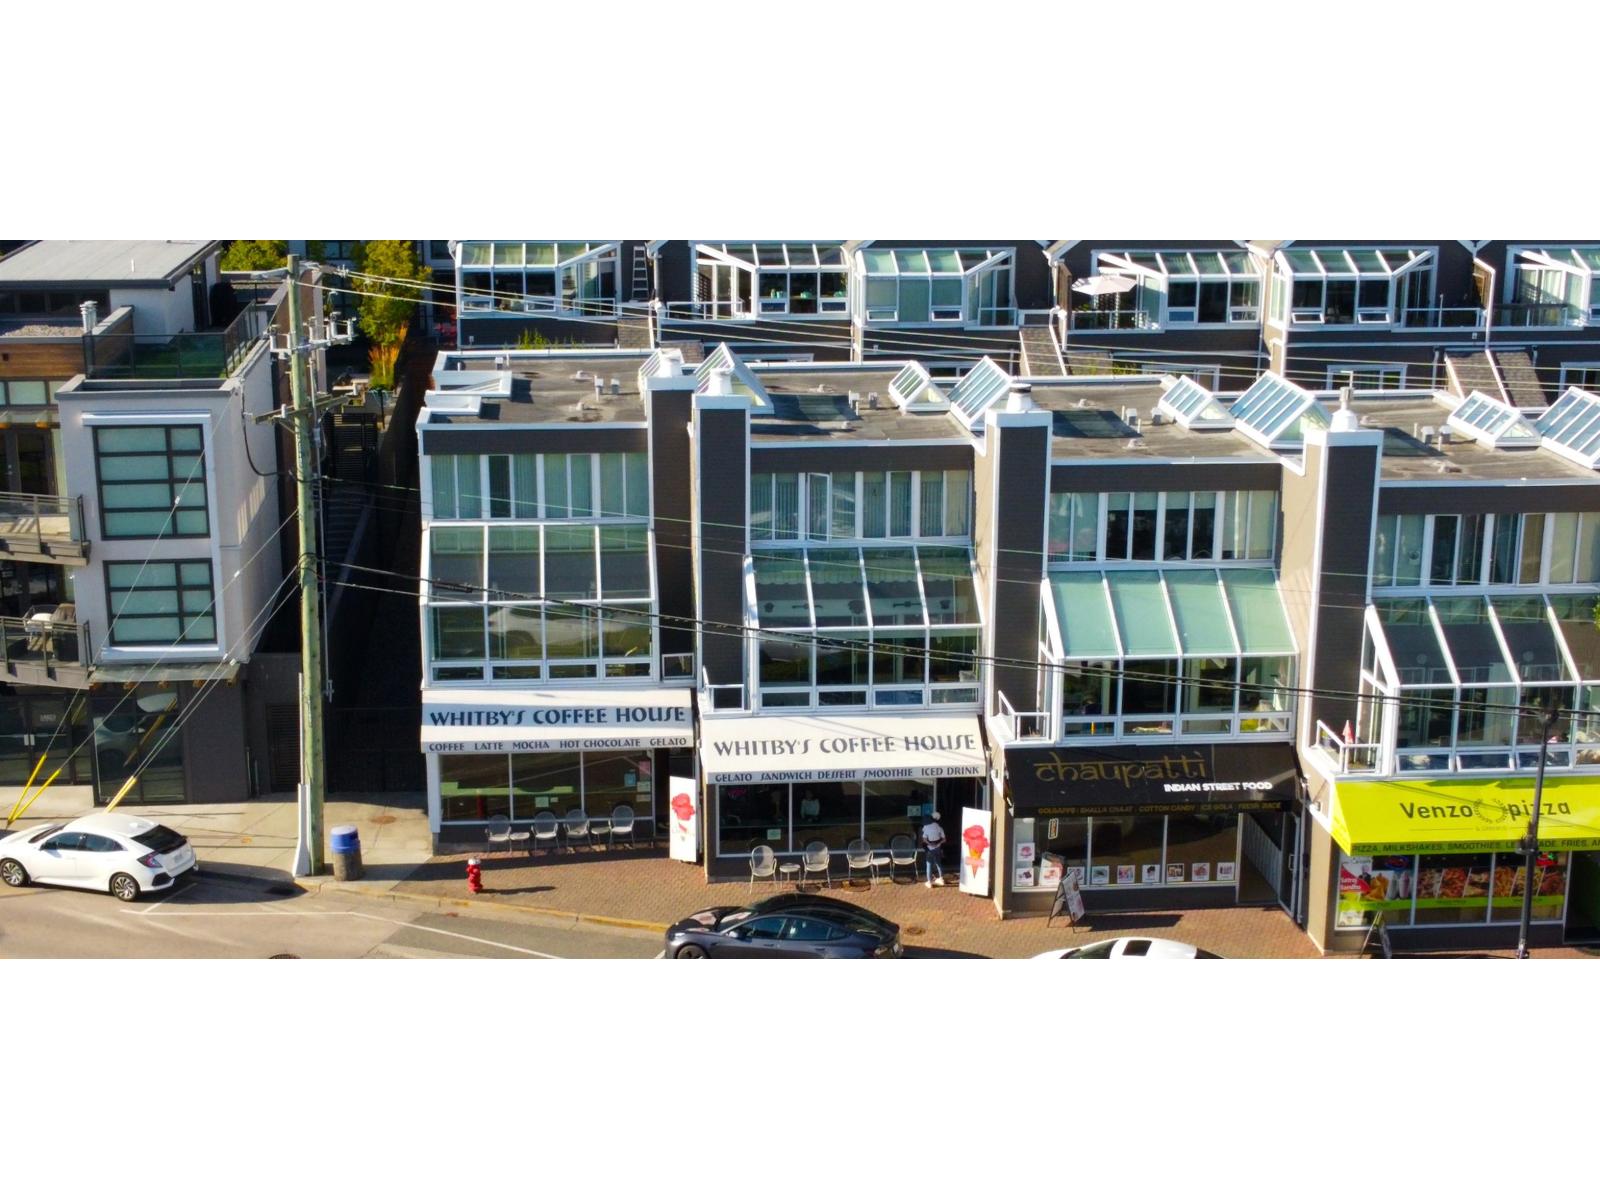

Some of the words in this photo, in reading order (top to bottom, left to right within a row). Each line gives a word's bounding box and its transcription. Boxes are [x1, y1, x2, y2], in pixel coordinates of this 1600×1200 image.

[430, 709, 526, 726] WHITBY'S
[533, 708, 607, 725] COFFEE
[616, 706, 685, 723] HOUSE
[429, 741, 465, 751] COFFEE
[474, 741, 503, 751] LATTE
[512, 740, 550, 749] MOCHA
[559, 739, 580, 749] HOT
[583, 738, 641, 748] CHOCOLATE
[649, 737, 687, 746] GELATO
[713, 739, 811, 756] WHITBY'S
[819, 736, 895, 754] COFFEE
[904, 734, 976, 751] HOUSE
[715, 772, 753, 782] GELATO
[760, 771, 812, 781] SANDWICH
[817, 769, 857, 779] DESSERT
[863, 768, 913, 778] SMOOTHIE
[921, 767, 943, 776] ICED
[947, 766, 979, 776] DRINK
[1034, 752, 1206, 788] chaupatti
[1163, 783, 1201, 792] INDIAN
[1202, 782, 1241, 792] STREET
[1242, 781, 1273, 791] FOOD
[1400, 802, 1473, 819] Venzo
